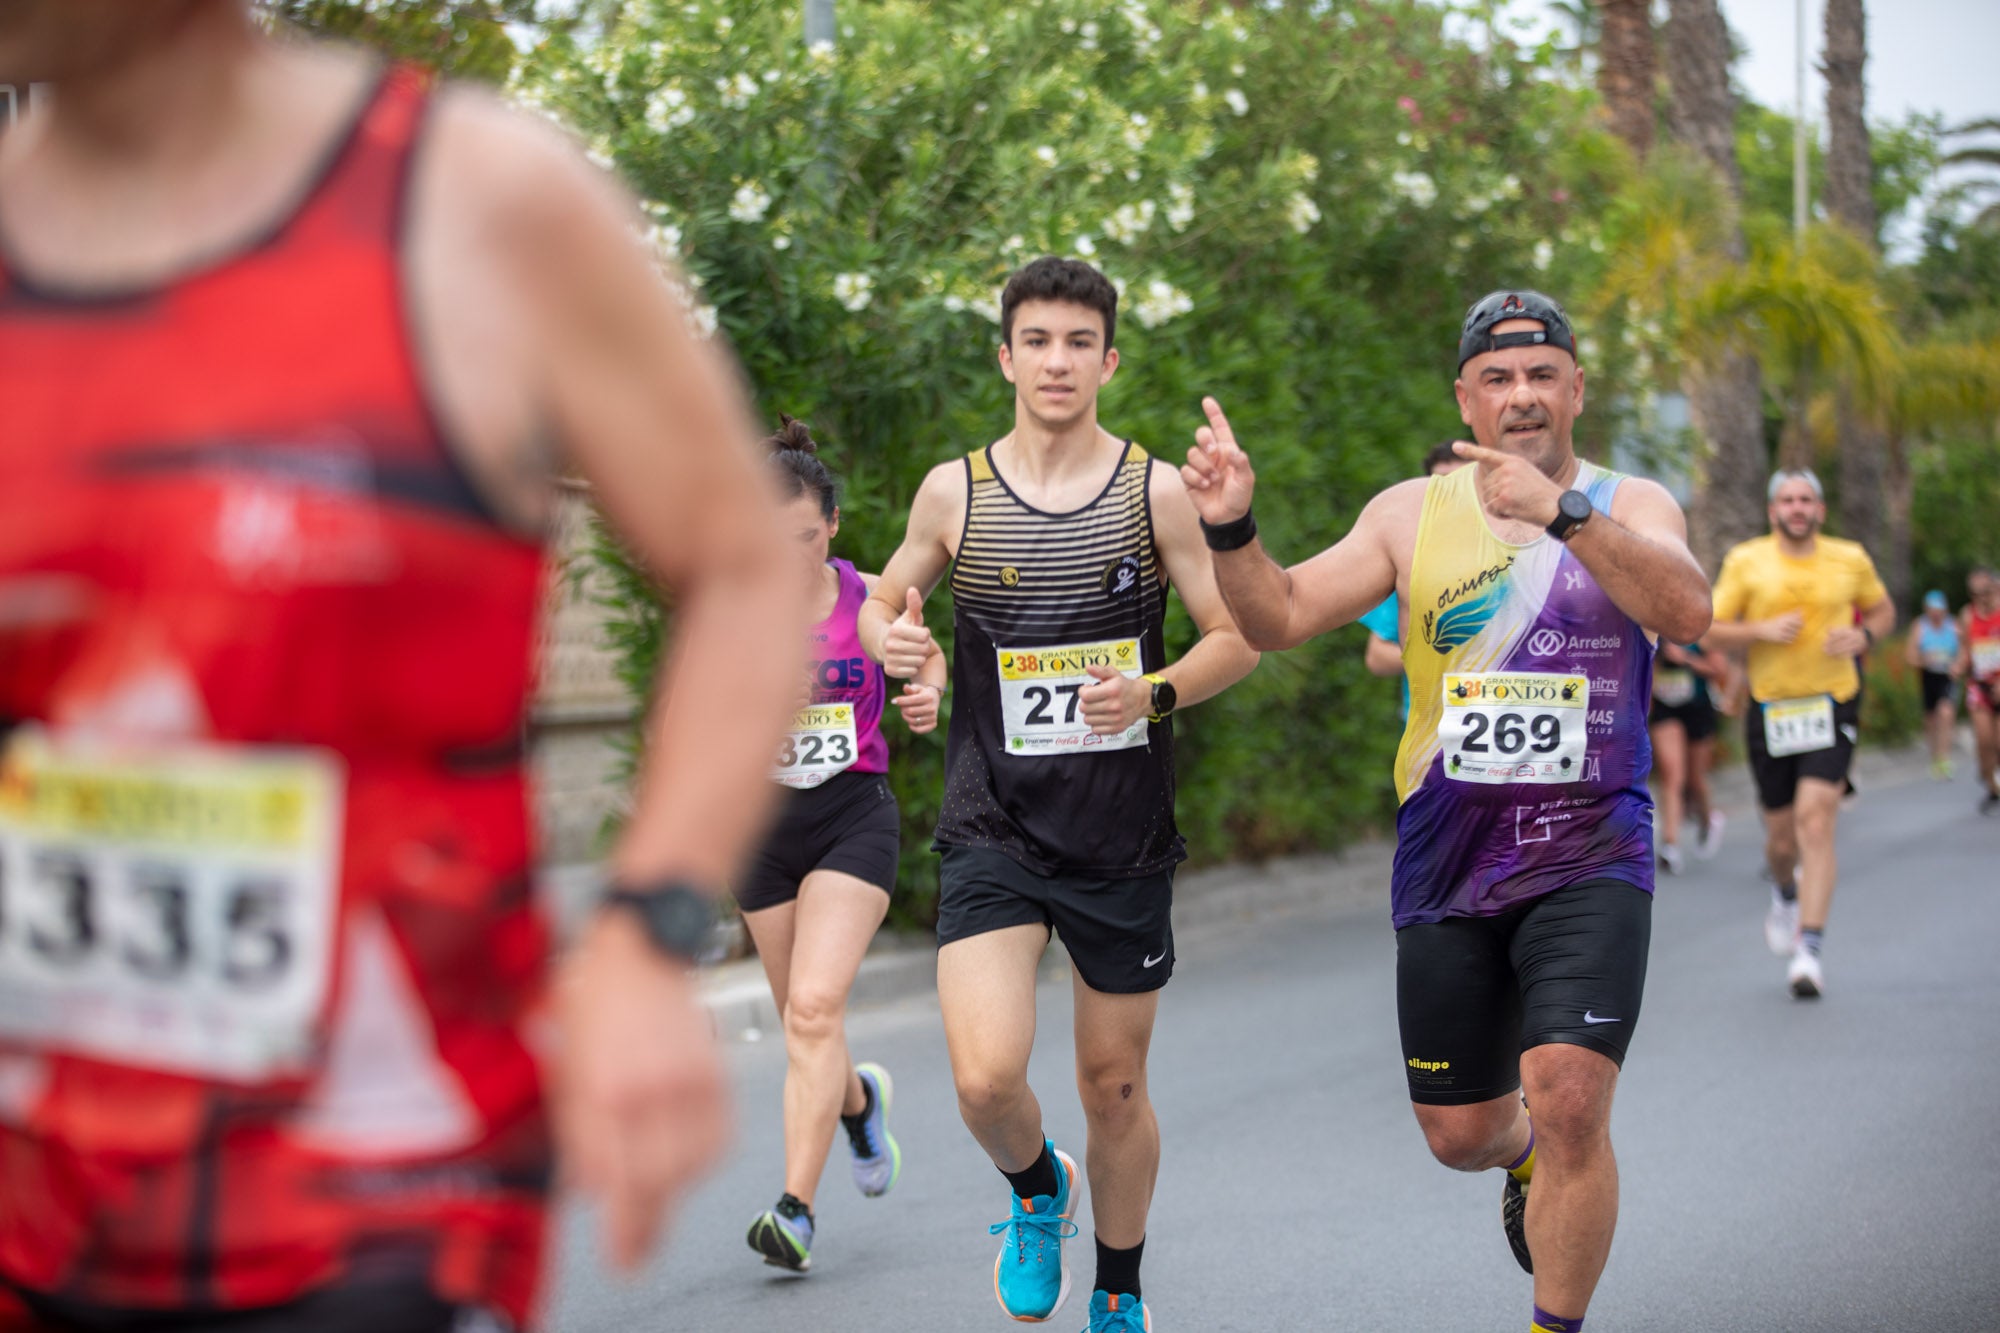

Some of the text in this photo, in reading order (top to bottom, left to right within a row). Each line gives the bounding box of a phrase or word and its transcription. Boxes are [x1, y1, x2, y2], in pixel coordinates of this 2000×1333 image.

[1567, 634, 1621, 650] Arrebola
[1041, 651, 1067, 659] GRAN
[1068, 647, 1103, 658] PREMIO
[1016, 655, 1038, 673] 38
[1514, 678, 1549, 686] PREMIO
[1482, 685, 1556, 700] FONDO
[1022, 682, 1101, 726] 27
[1585, 710, 1615, 725] MAS
[1461, 712, 1561, 755] 269
[1580, 756, 1601, 782] DA
[0, 848, 294, 996] 335
[1408, 1057, 1450, 1072] olimpo
